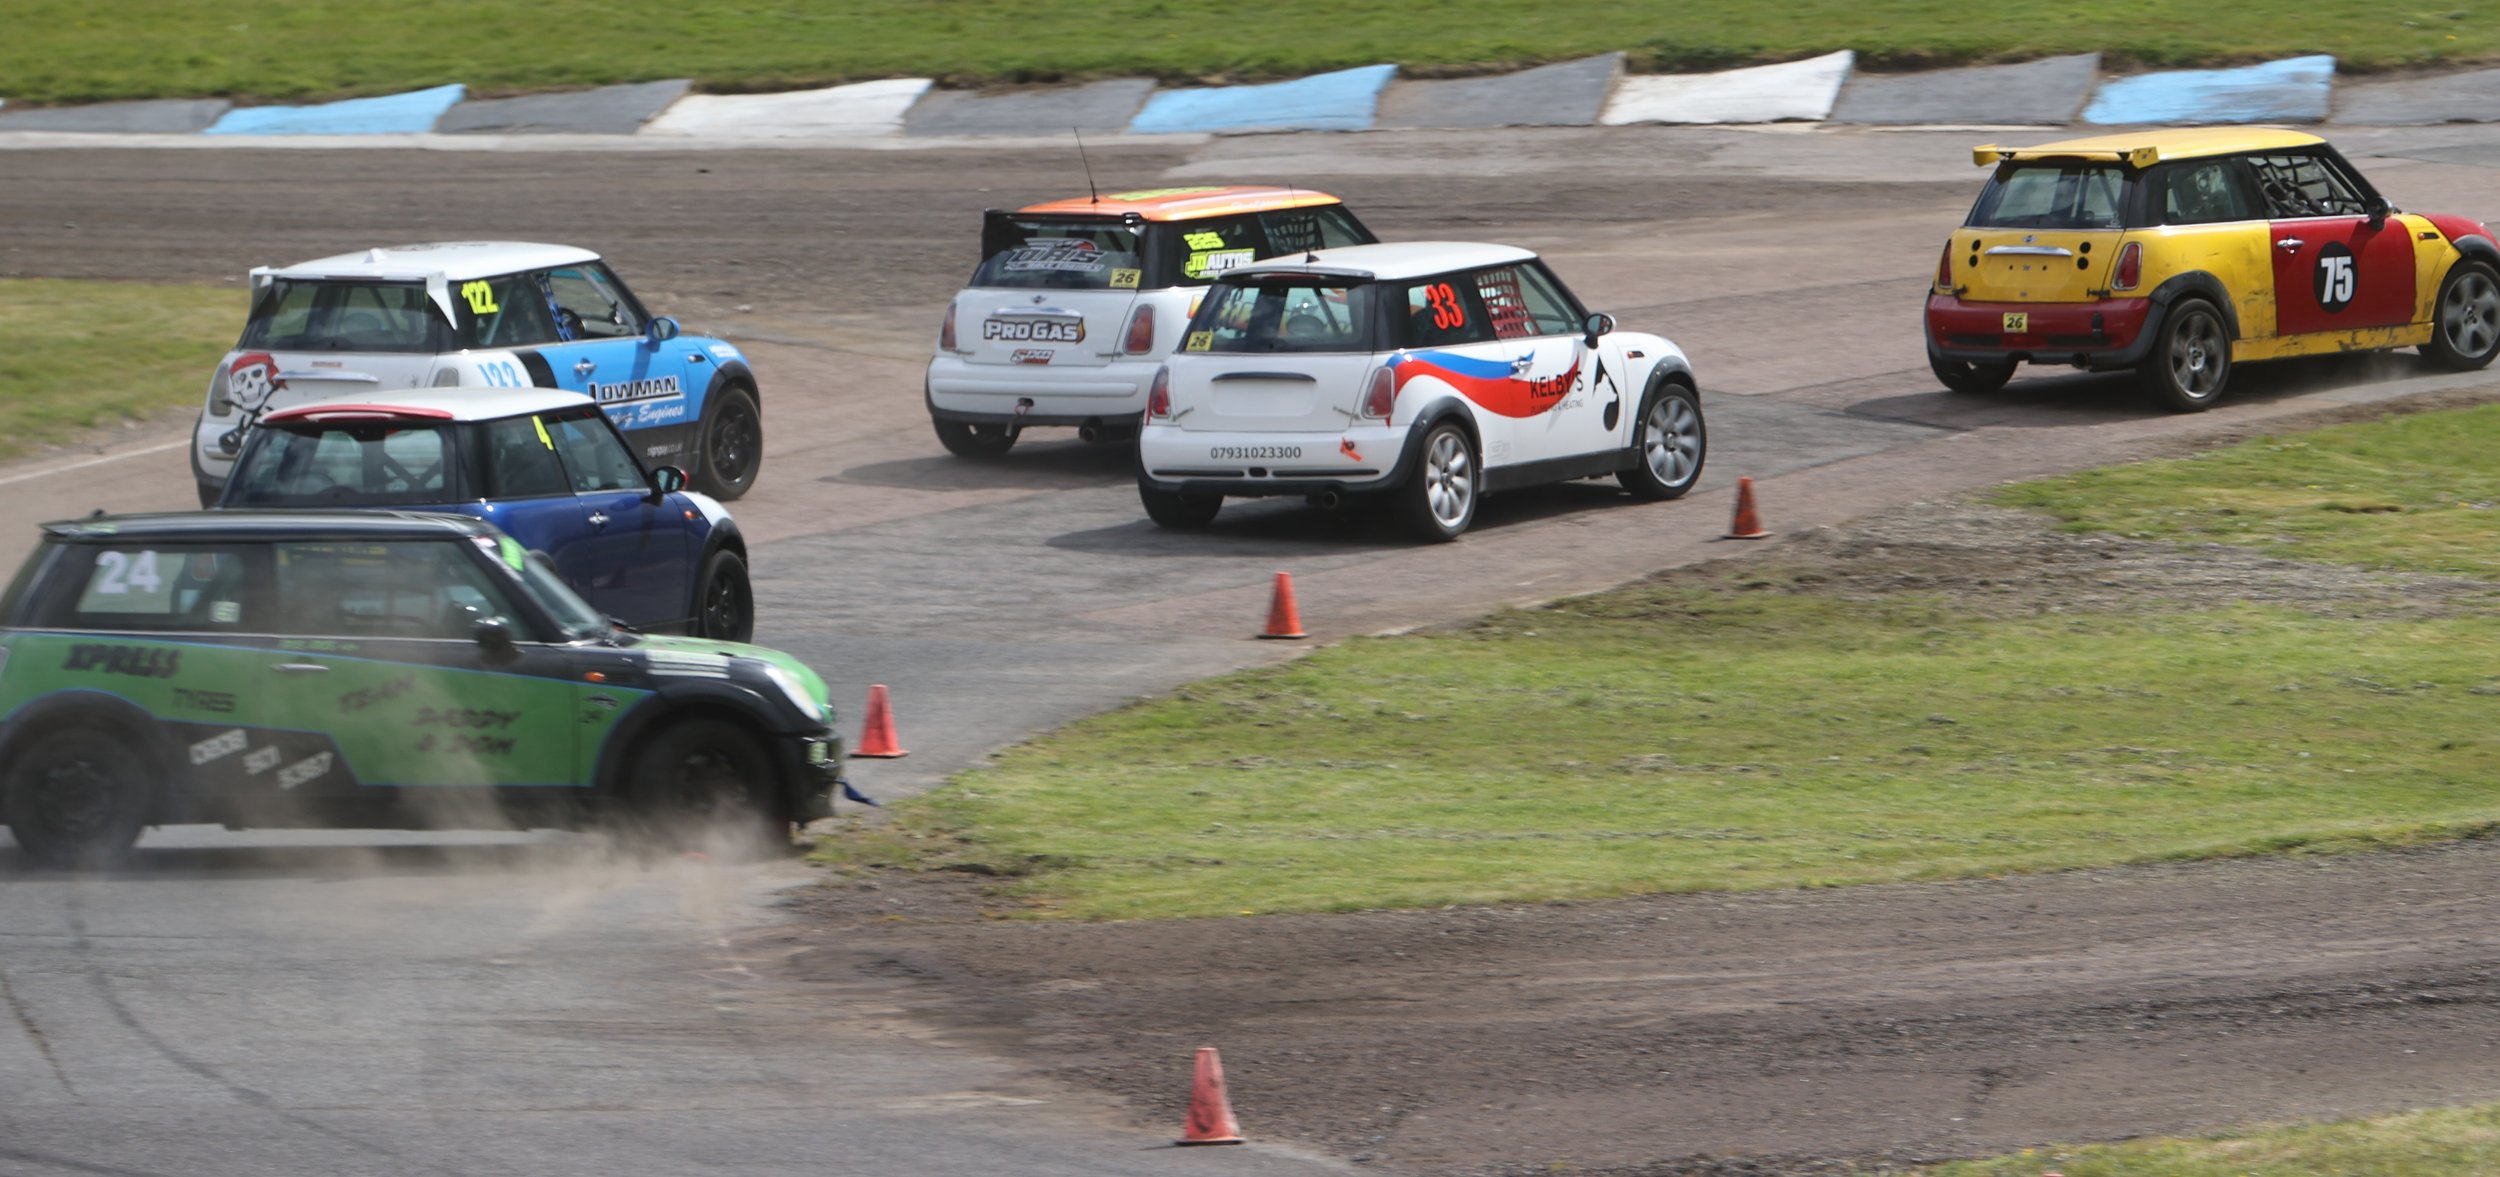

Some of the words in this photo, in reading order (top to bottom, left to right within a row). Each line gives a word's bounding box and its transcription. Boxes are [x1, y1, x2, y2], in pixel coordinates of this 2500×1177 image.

[1115, 272, 1135, 284] 26
[2320, 256, 2354, 303] 75
[461, 280, 499, 314] 122
[1425, 282, 1464, 330] 33
[2006, 317, 2023, 329] 26
[1530, 370, 1584, 398] KELBY'S
[638, 404, 684, 424] Engines
[1210, 446, 1302, 459] 07931023300
[96, 550, 161, 594] 24
[62, 644, 182, 680] XPRESS
